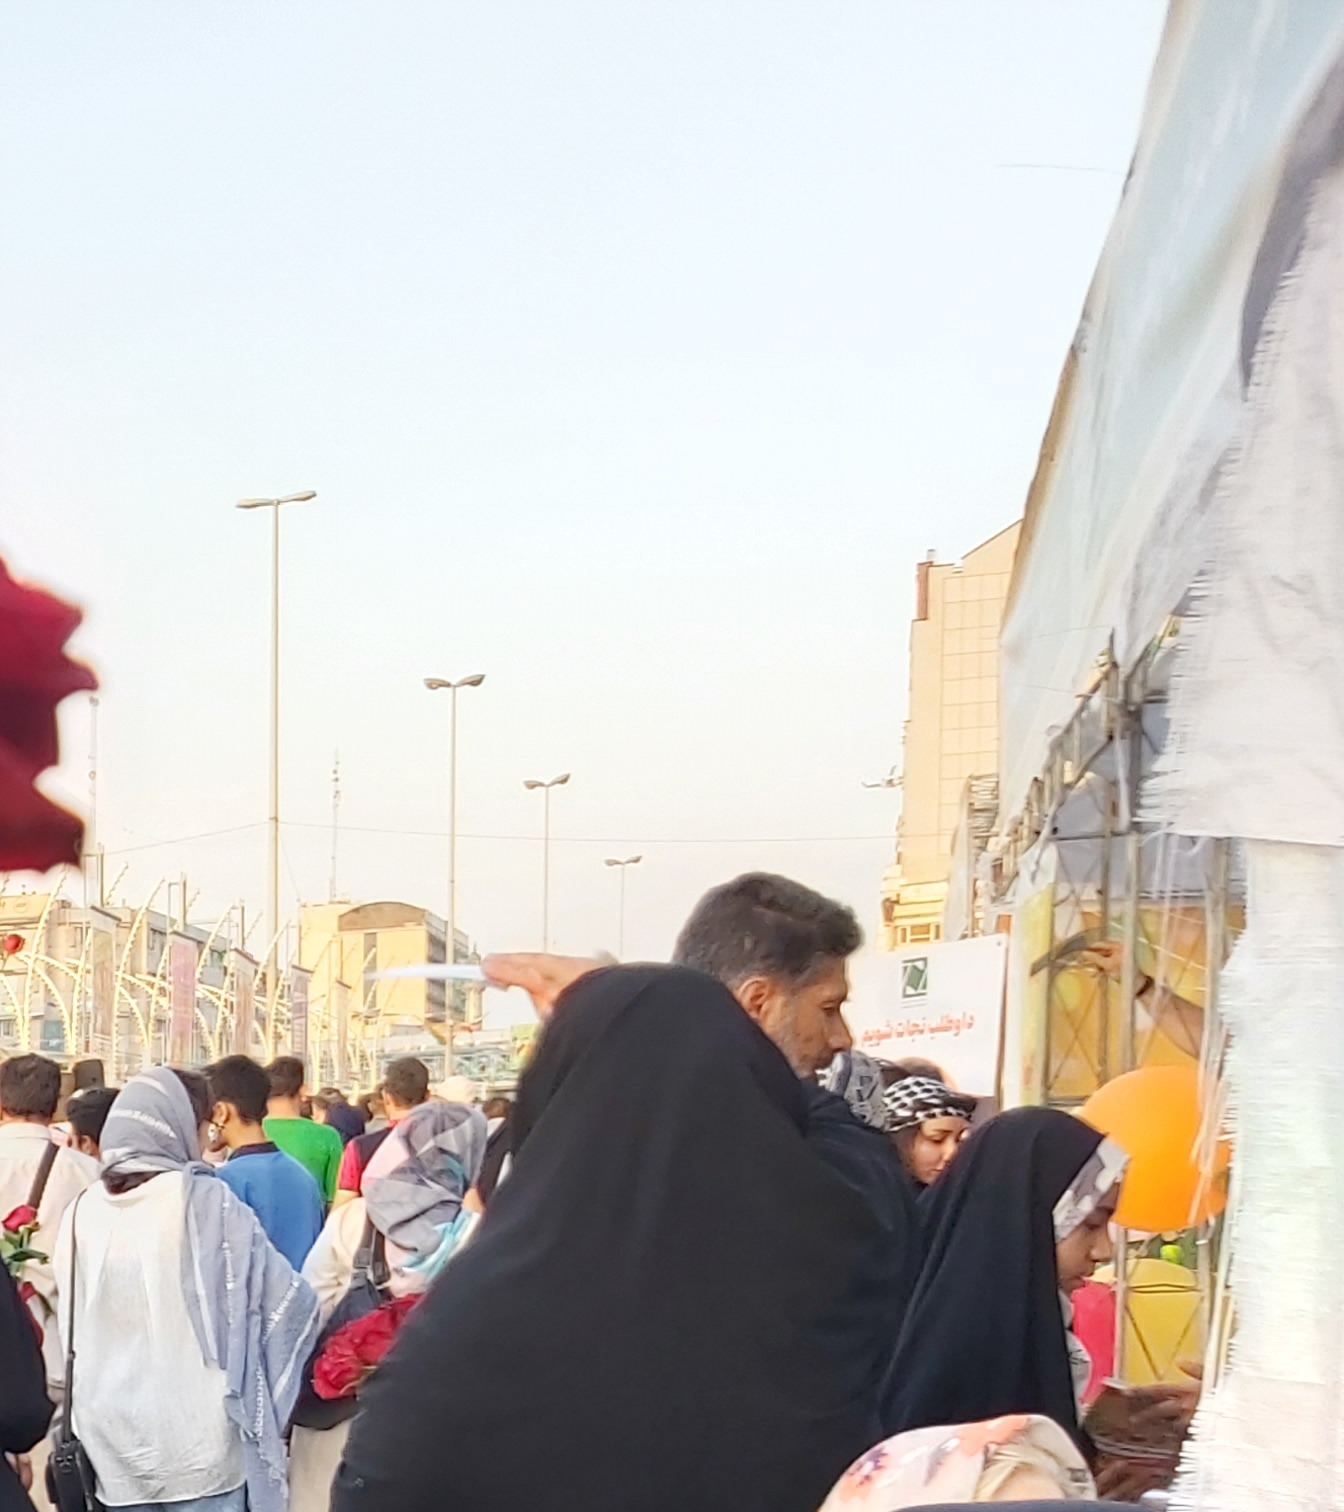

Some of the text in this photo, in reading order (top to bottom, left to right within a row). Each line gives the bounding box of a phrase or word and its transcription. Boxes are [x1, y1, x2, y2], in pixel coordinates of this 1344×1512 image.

[861, 1011, 975, 1046] داوطلب نجات شویم
